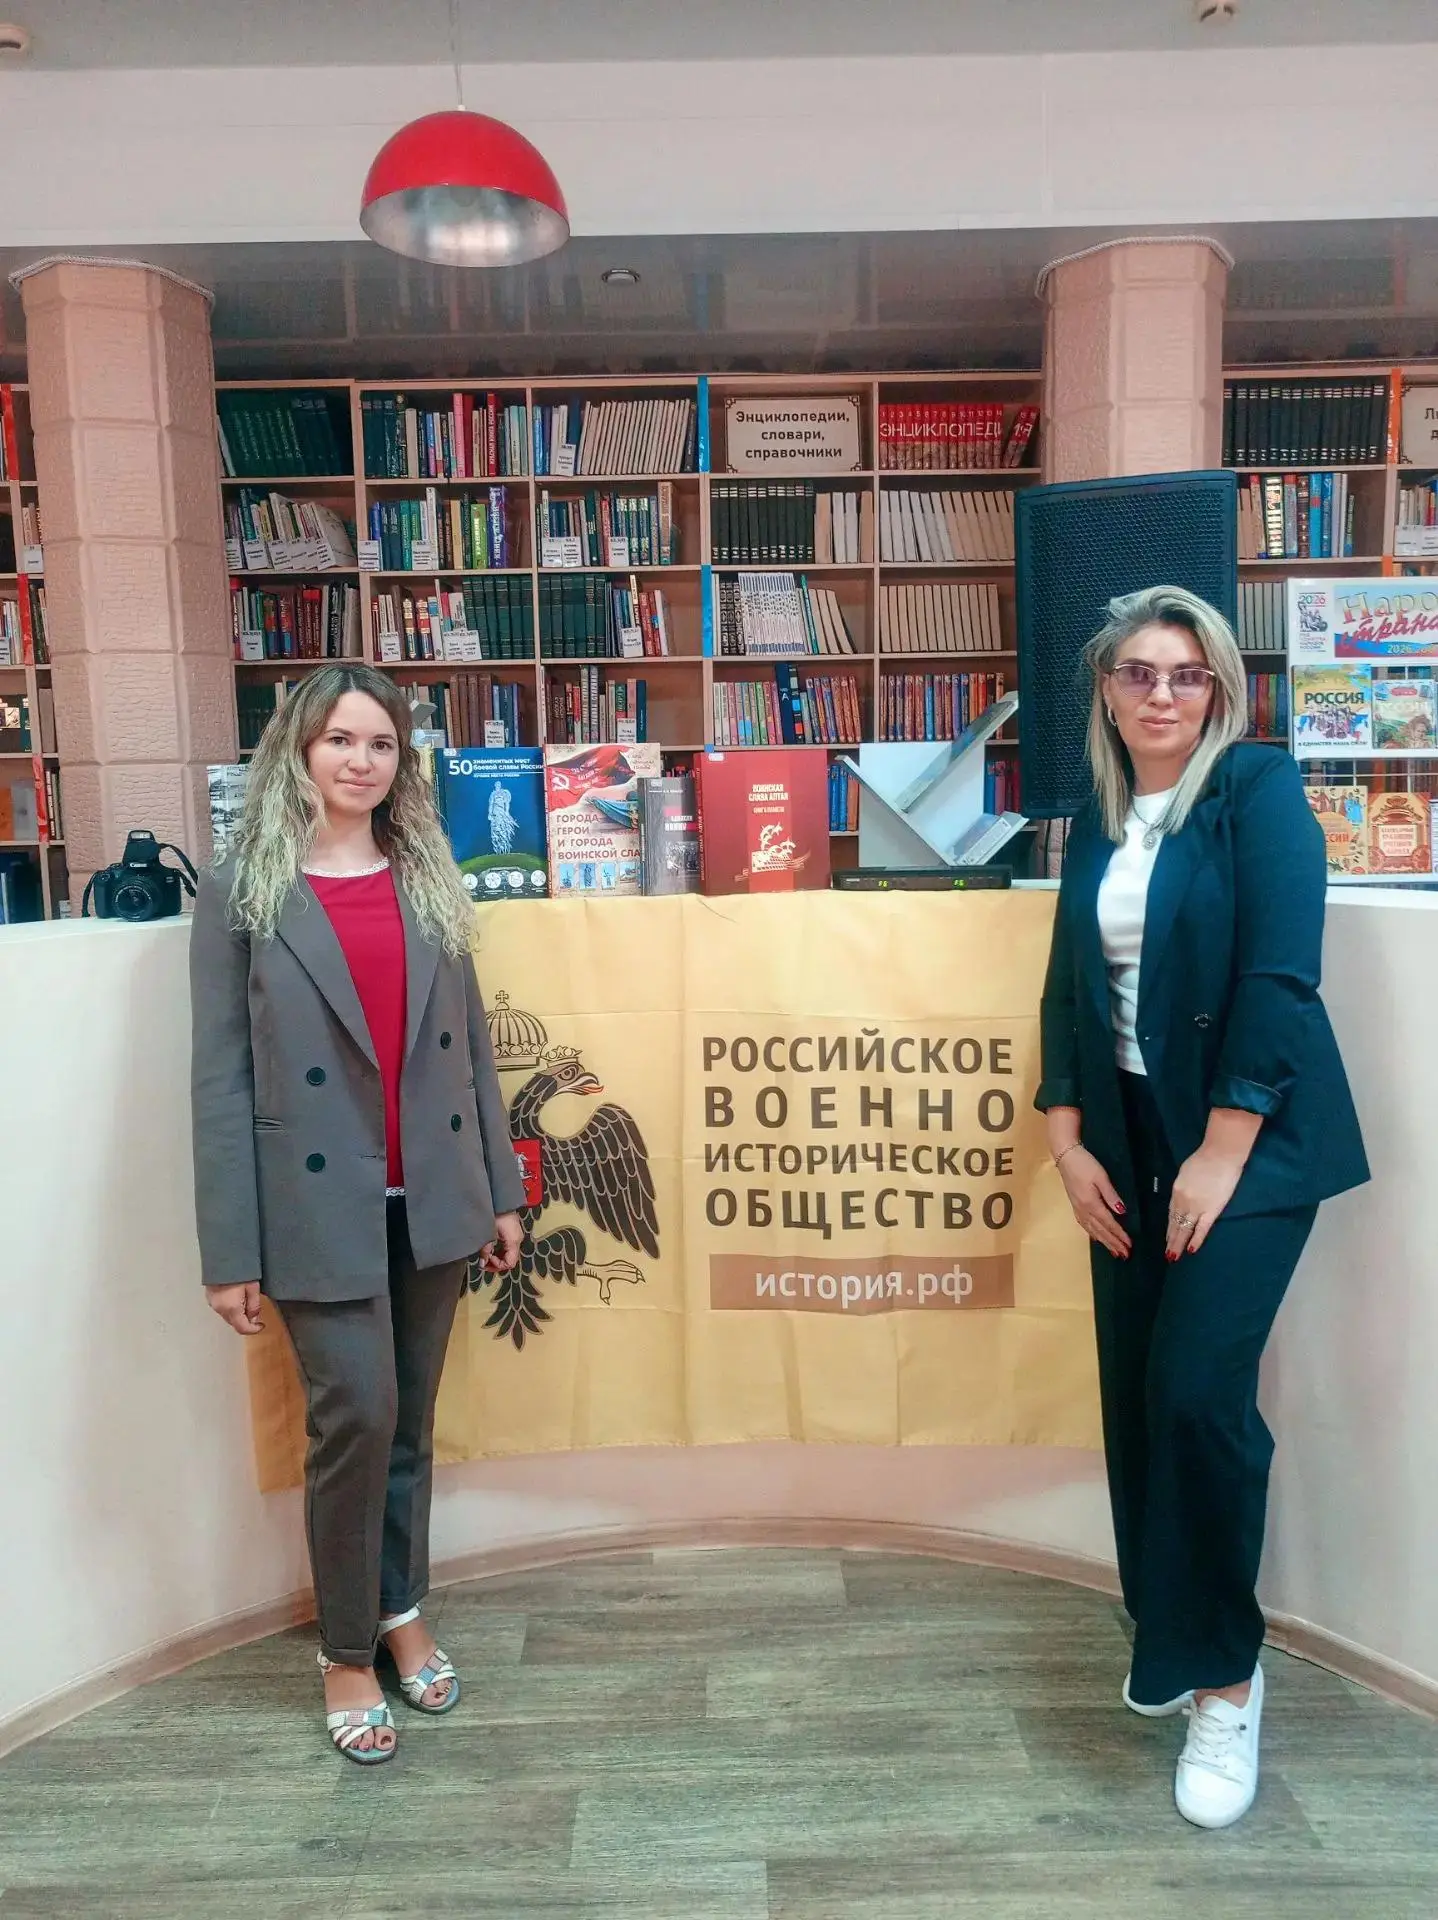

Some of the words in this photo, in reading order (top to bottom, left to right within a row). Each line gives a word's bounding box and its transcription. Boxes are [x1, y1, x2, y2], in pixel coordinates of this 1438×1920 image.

[735, 411, 850, 424] Энциклопедии,
[761, 430, 825, 443] словари,
[745, 447, 842, 461] справочники
[1299, 594, 1326, 605] 2026
[1304, 692, 1365, 705] РОССИЯ
[449, 760, 473, 775] 50
[748, 793, 768, 802] СЛАВА
[556, 814, 599, 824] ГОРОДА
[556, 826, 590, 836] ГЕРОИ
[557, 839, 565, 848] И
[570, 837, 613, 848] ГОРОДА
[558, 848, 617, 860] ВОИНСКОЙ
[702, 1027, 1014, 1075] РОССИЙСКОЕ
[704, 1085, 1015, 1133] ВОЕННО
[704, 1142, 1014, 1177] ИСТОРИЧЕСКОЕ
[705, 1187, 1013, 1240] ОБЩЕСТВО
[755, 1264, 973, 1309] история.рф
